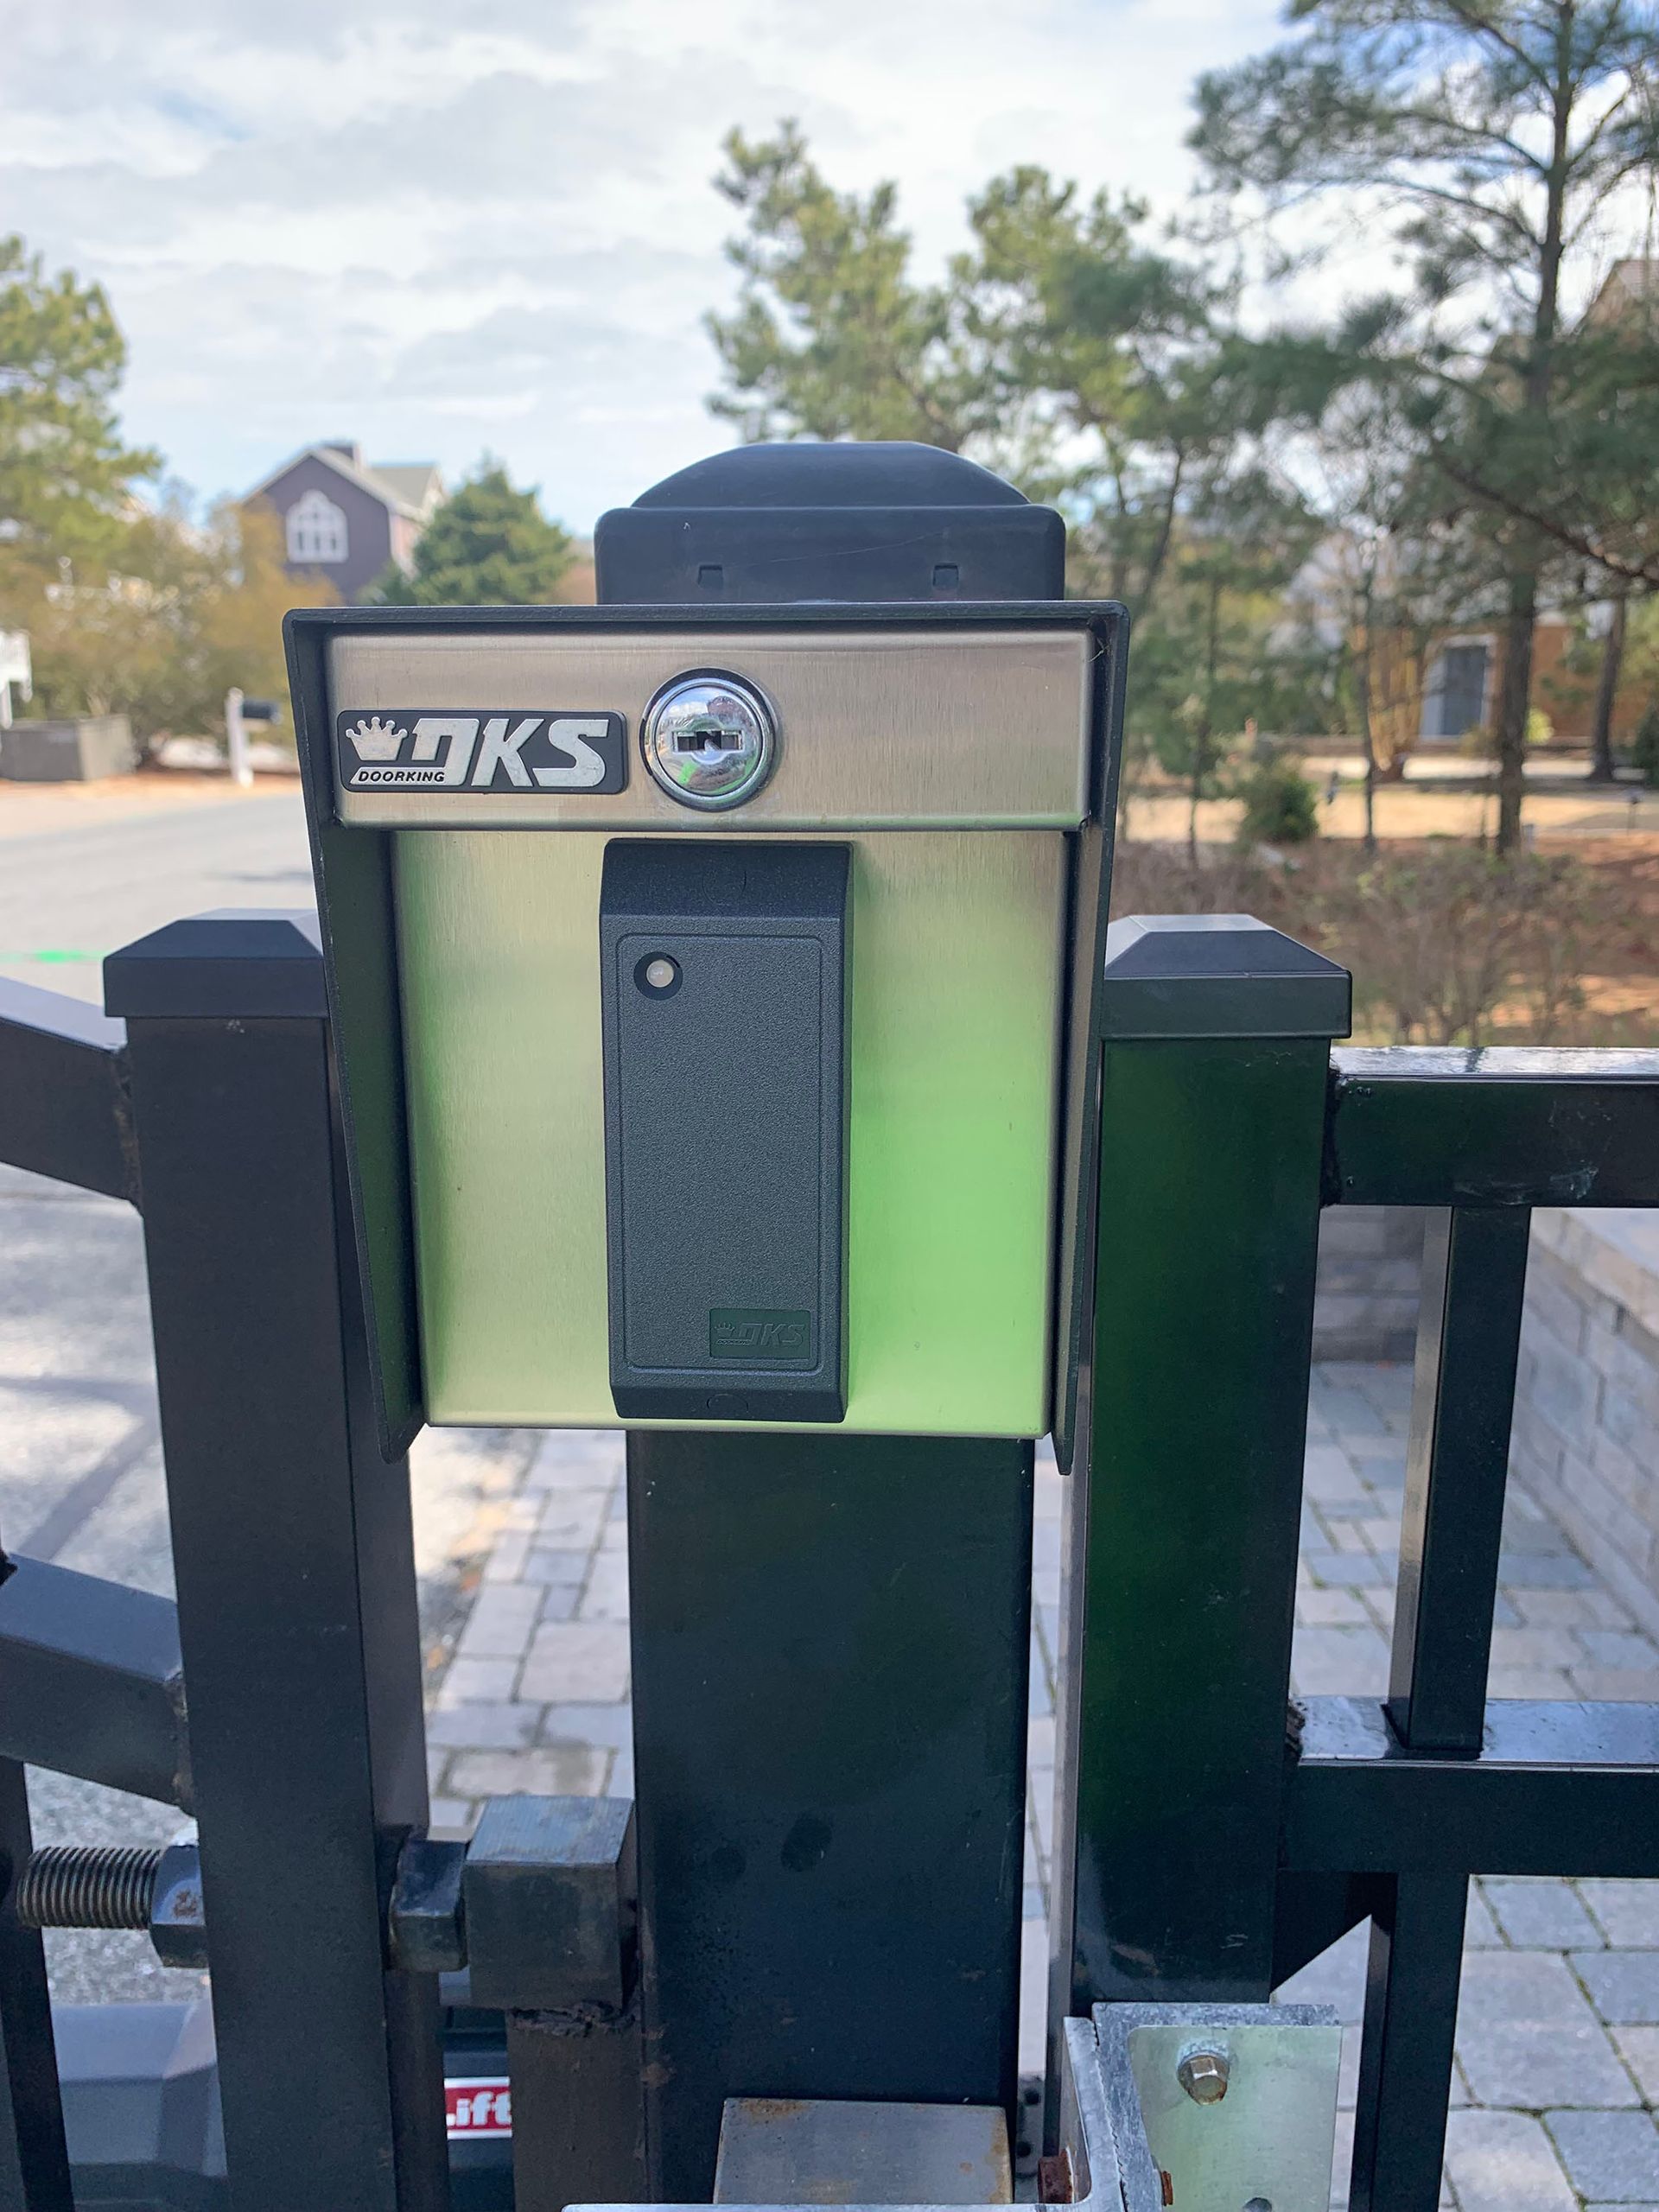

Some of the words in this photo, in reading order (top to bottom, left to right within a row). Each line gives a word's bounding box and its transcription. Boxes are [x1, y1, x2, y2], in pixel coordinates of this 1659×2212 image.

[410, 718, 609, 787] DKS
[358, 771, 445, 783] DOORKING
[738, 1322, 805, 1347] DKS
